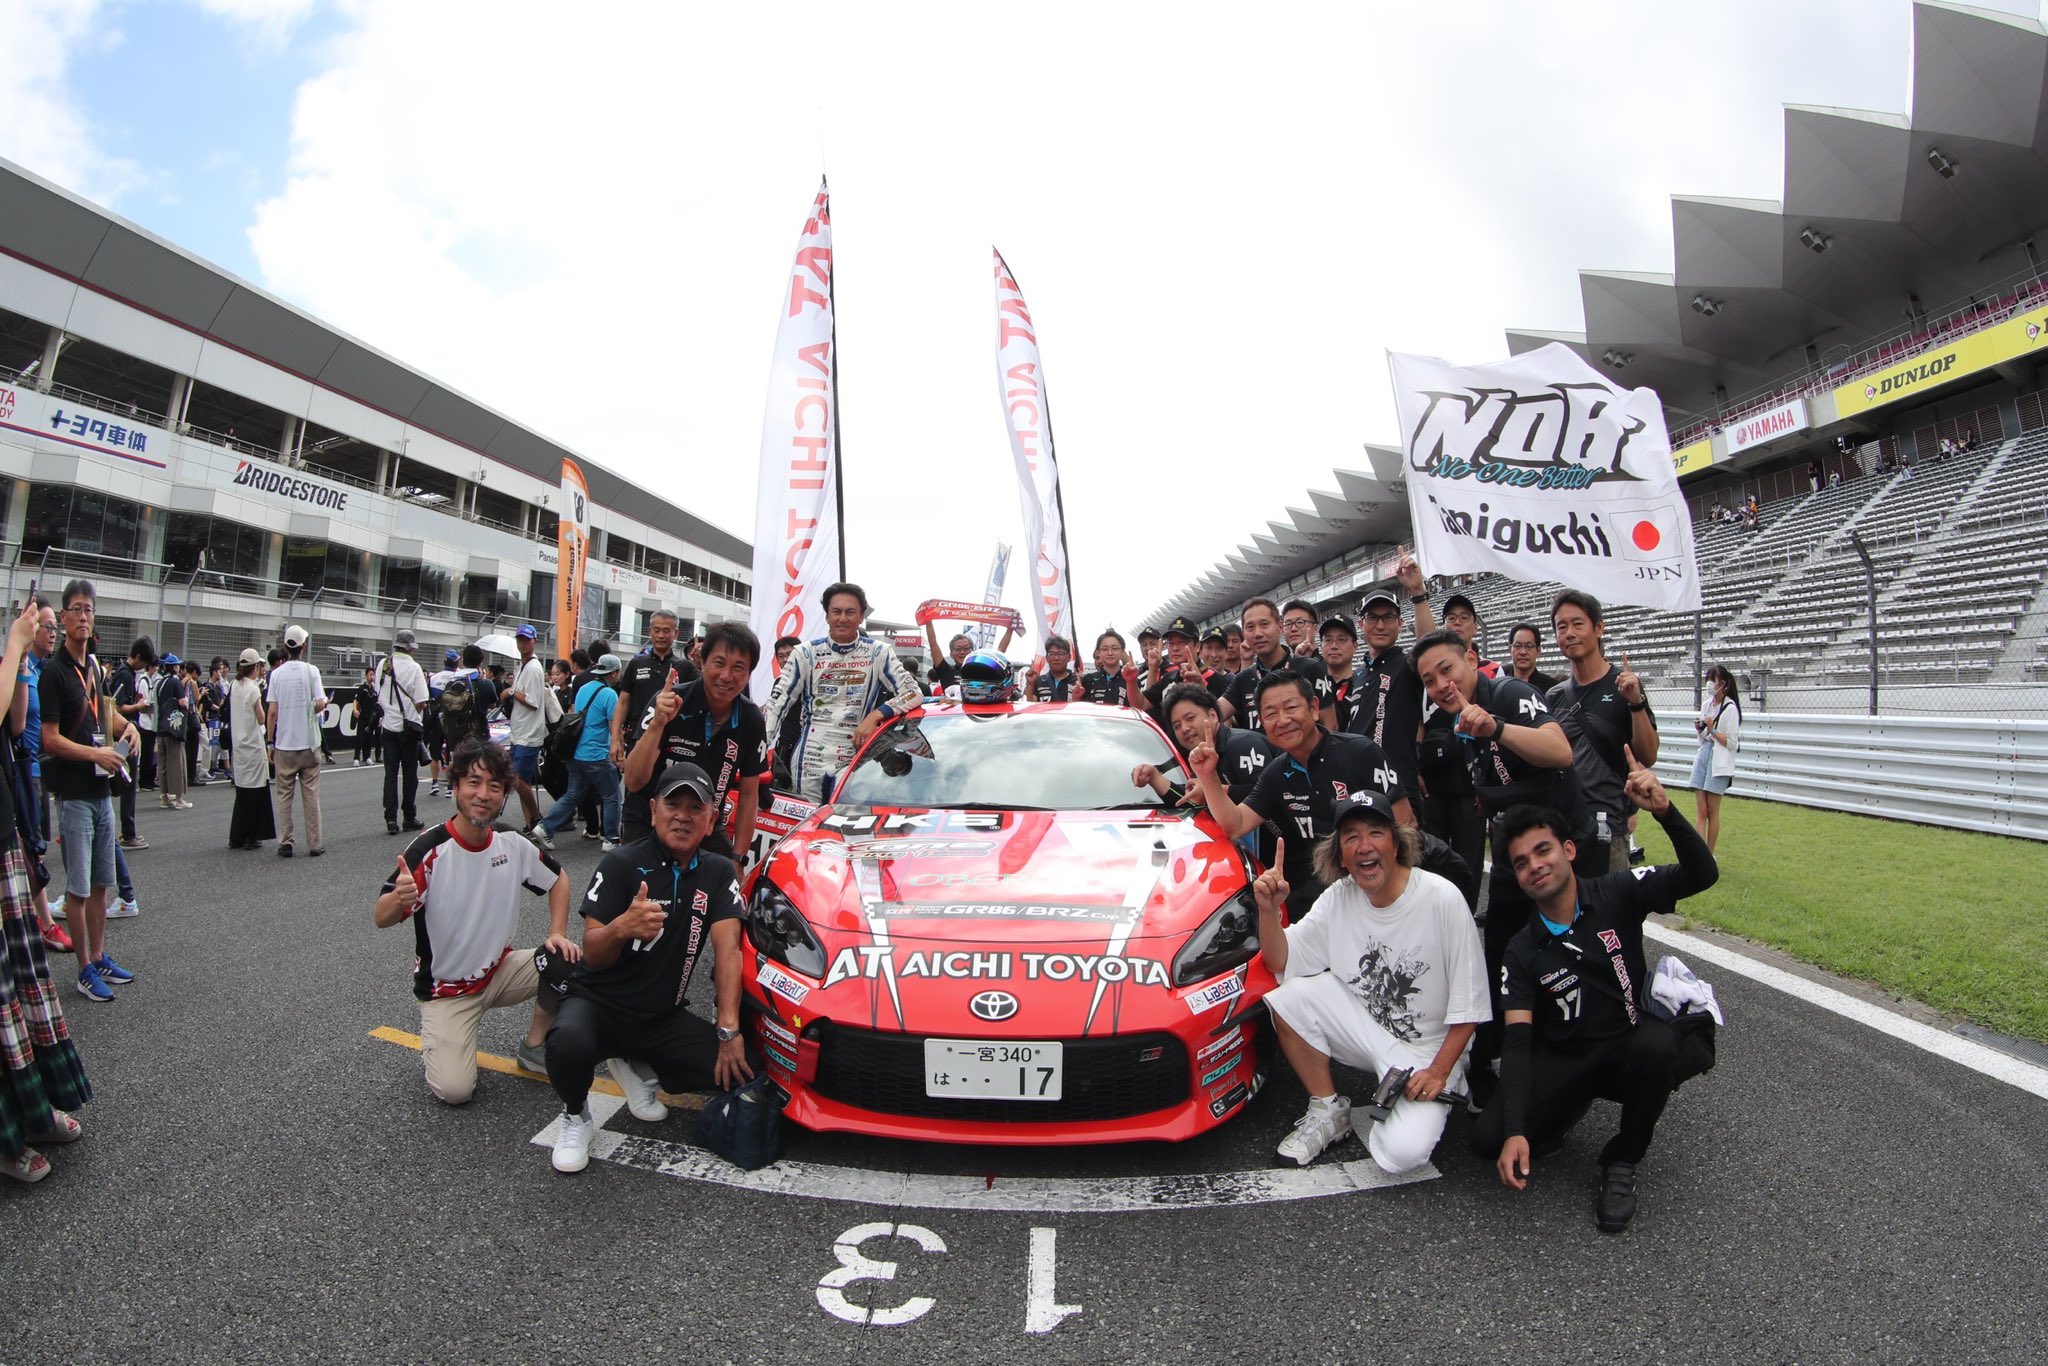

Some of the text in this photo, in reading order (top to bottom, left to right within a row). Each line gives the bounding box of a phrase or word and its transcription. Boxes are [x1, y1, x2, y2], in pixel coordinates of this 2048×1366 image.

[1880, 353, 1956, 394] DUNLOP
[51, 409, 148, 453] トヨタ車体
[1747, 408, 1794, 440] YAMAHA
[233, 460, 348, 511] BRIDGESTONE
[1476, 462, 1539, 488] One
[1538, 462, 1604, 490] Better
[538, 550, 558, 565] Panas
[1384, 562, 1400, 576] NISS
[1635, 564, 1683, 581] JPN
[725, 738, 739, 762] AT
[716, 761, 733, 791] AICHI
[820, 812, 1000, 833] HKS
[691, 889, 708, 915] AT
[686, 915, 703, 954] AICHI
[1597, 928, 1621, 953] AT
[820, 945, 1172, 990] AT AICHI TOYOTA
[934, 1071, 950, 1086] は
[1019, 1066, 1055, 1096] 17
